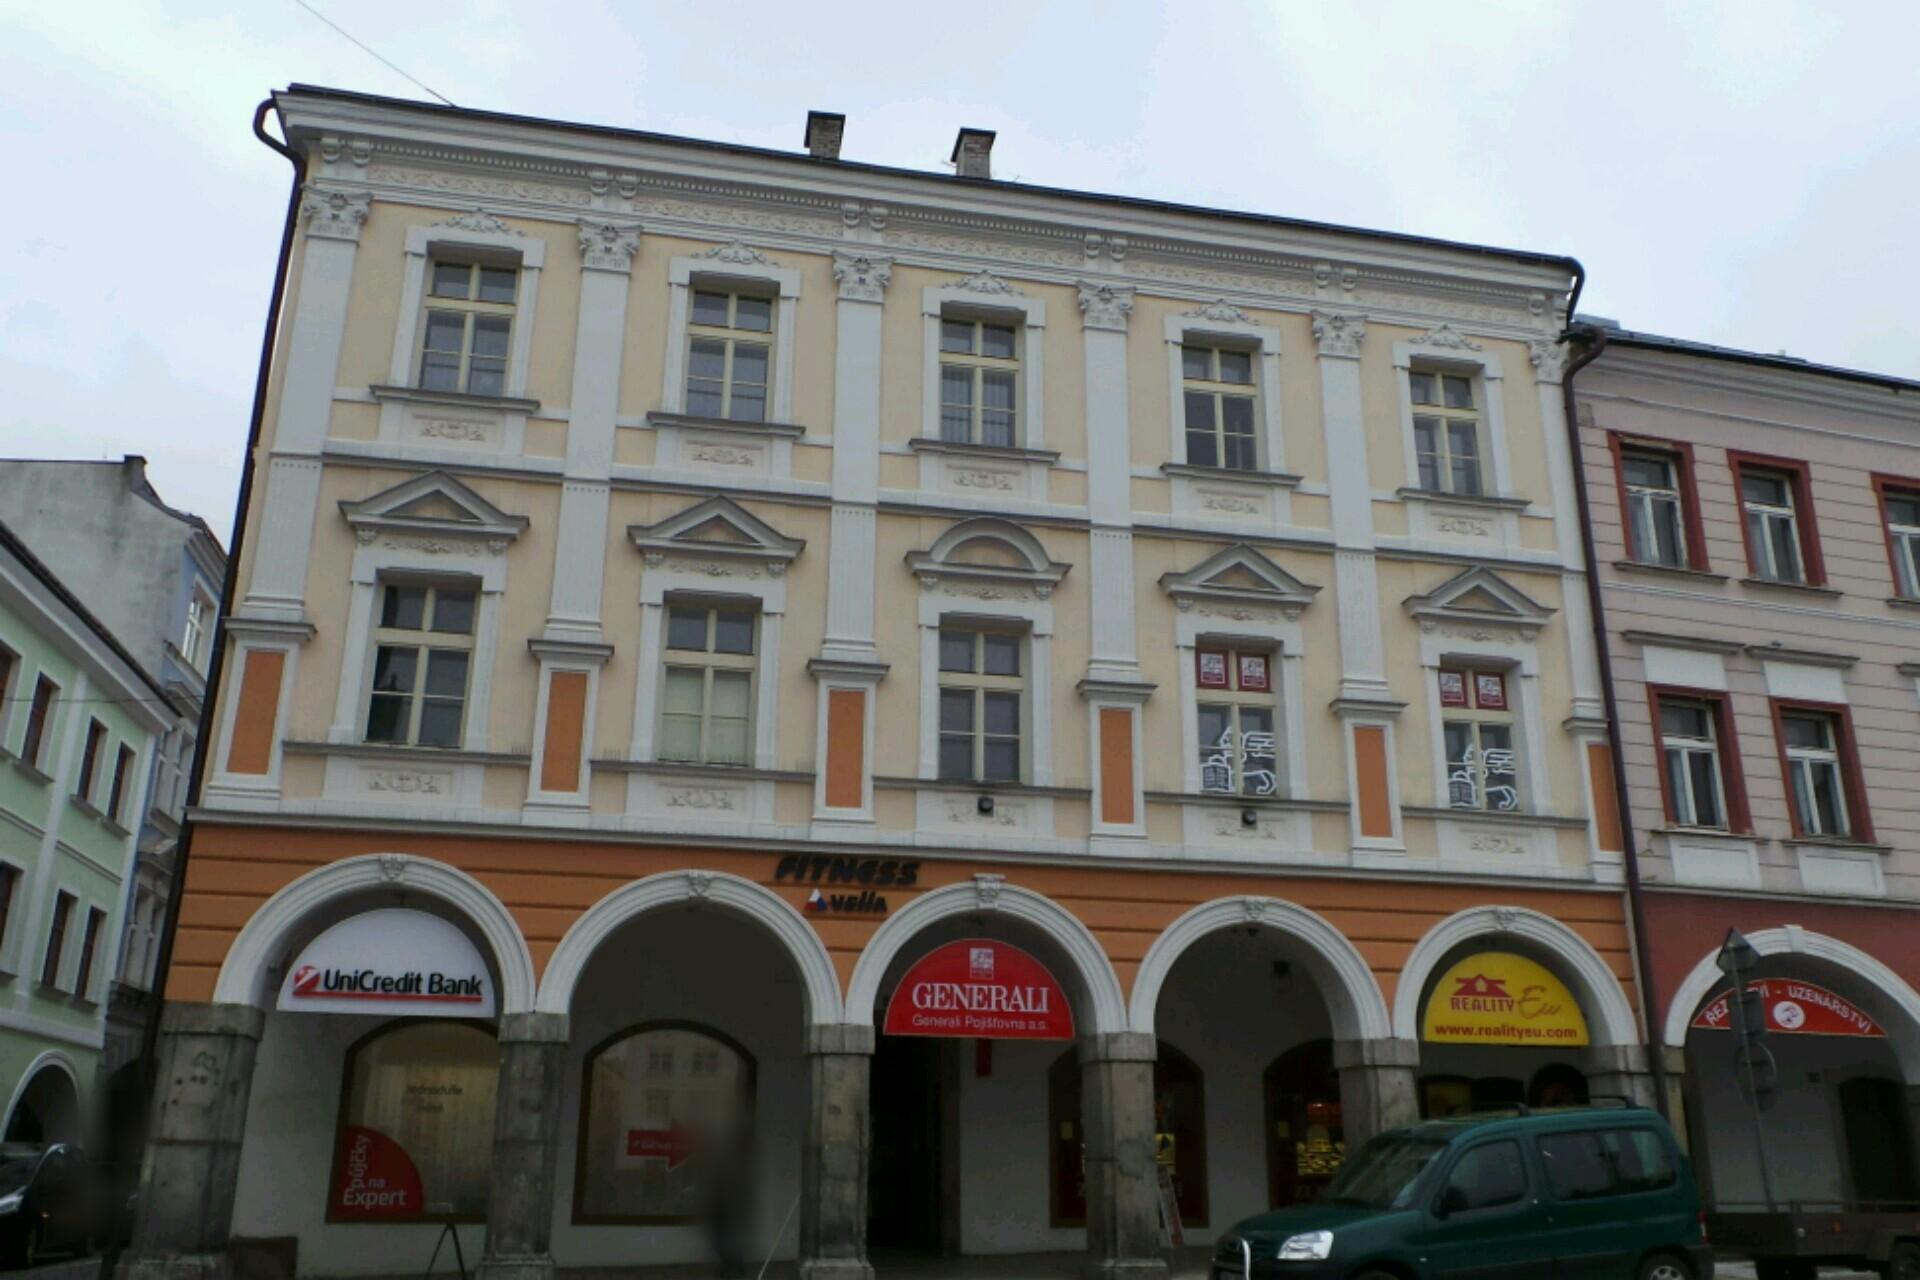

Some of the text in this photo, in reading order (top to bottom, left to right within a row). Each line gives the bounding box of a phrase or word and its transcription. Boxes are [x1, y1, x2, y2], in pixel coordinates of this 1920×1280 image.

[776, 857, 919, 884] FITNESS
[324, 969, 481, 996] UniCredit Bank
[912, 982, 1049, 1013] GENERALI
[1451, 997, 1513, 1012] REALITY
[912, 1013, 960, 1028] Generali
[1435, 1024, 1577, 1039] www.realityeu.com
[368, 1177, 386, 1189] na
[343, 1188, 407, 1211] Expert
